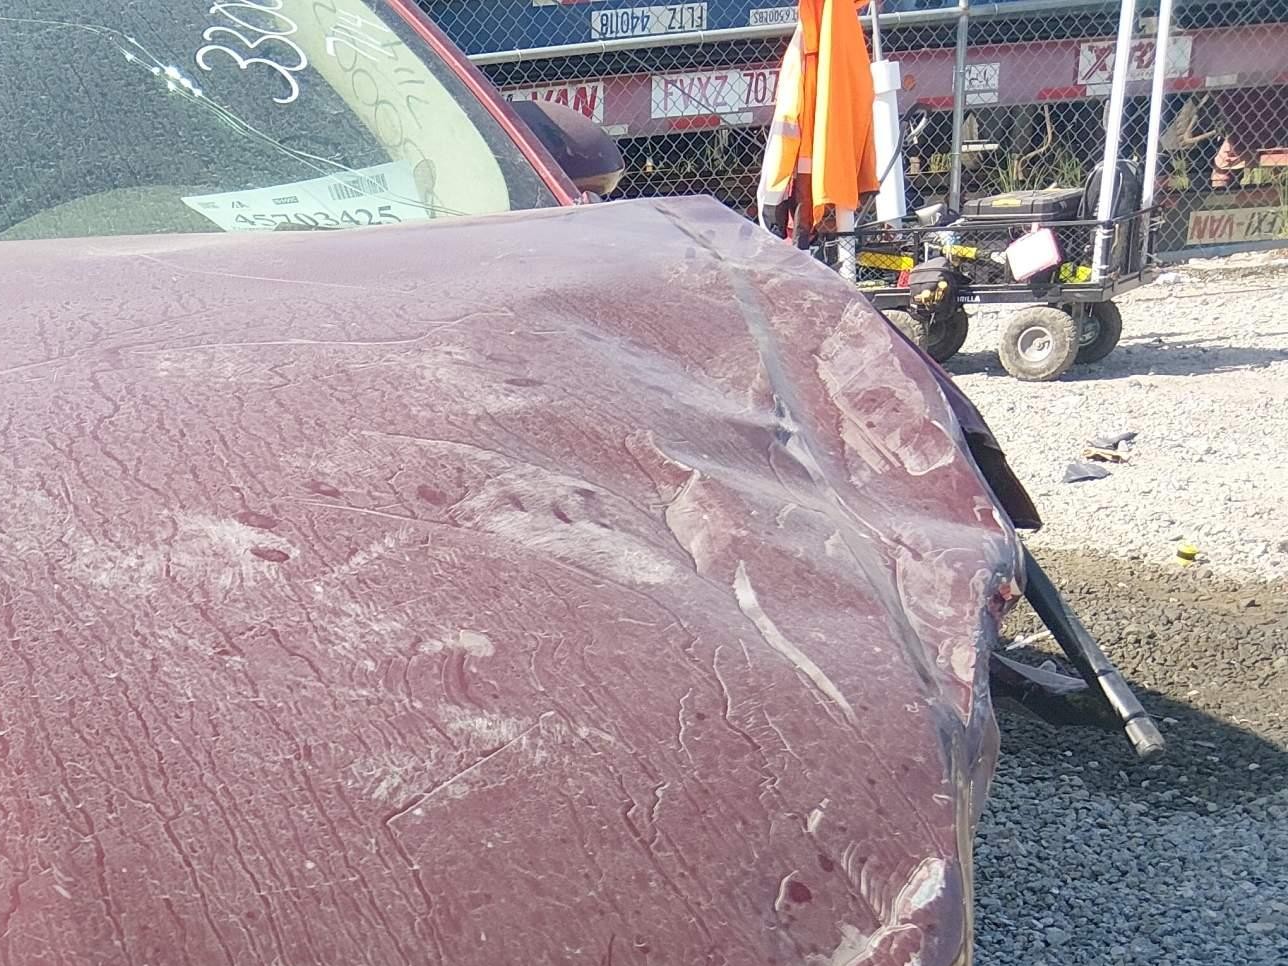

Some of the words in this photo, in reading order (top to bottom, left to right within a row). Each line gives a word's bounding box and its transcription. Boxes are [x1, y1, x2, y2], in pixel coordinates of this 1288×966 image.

[600, 10, 650, 35] 440118
[667, 6, 703, 29] FLTZ
[196, 0, 309, 104] 330
[531, 86, 598, 119] AN
[235, 206, 402, 228] 45703425
